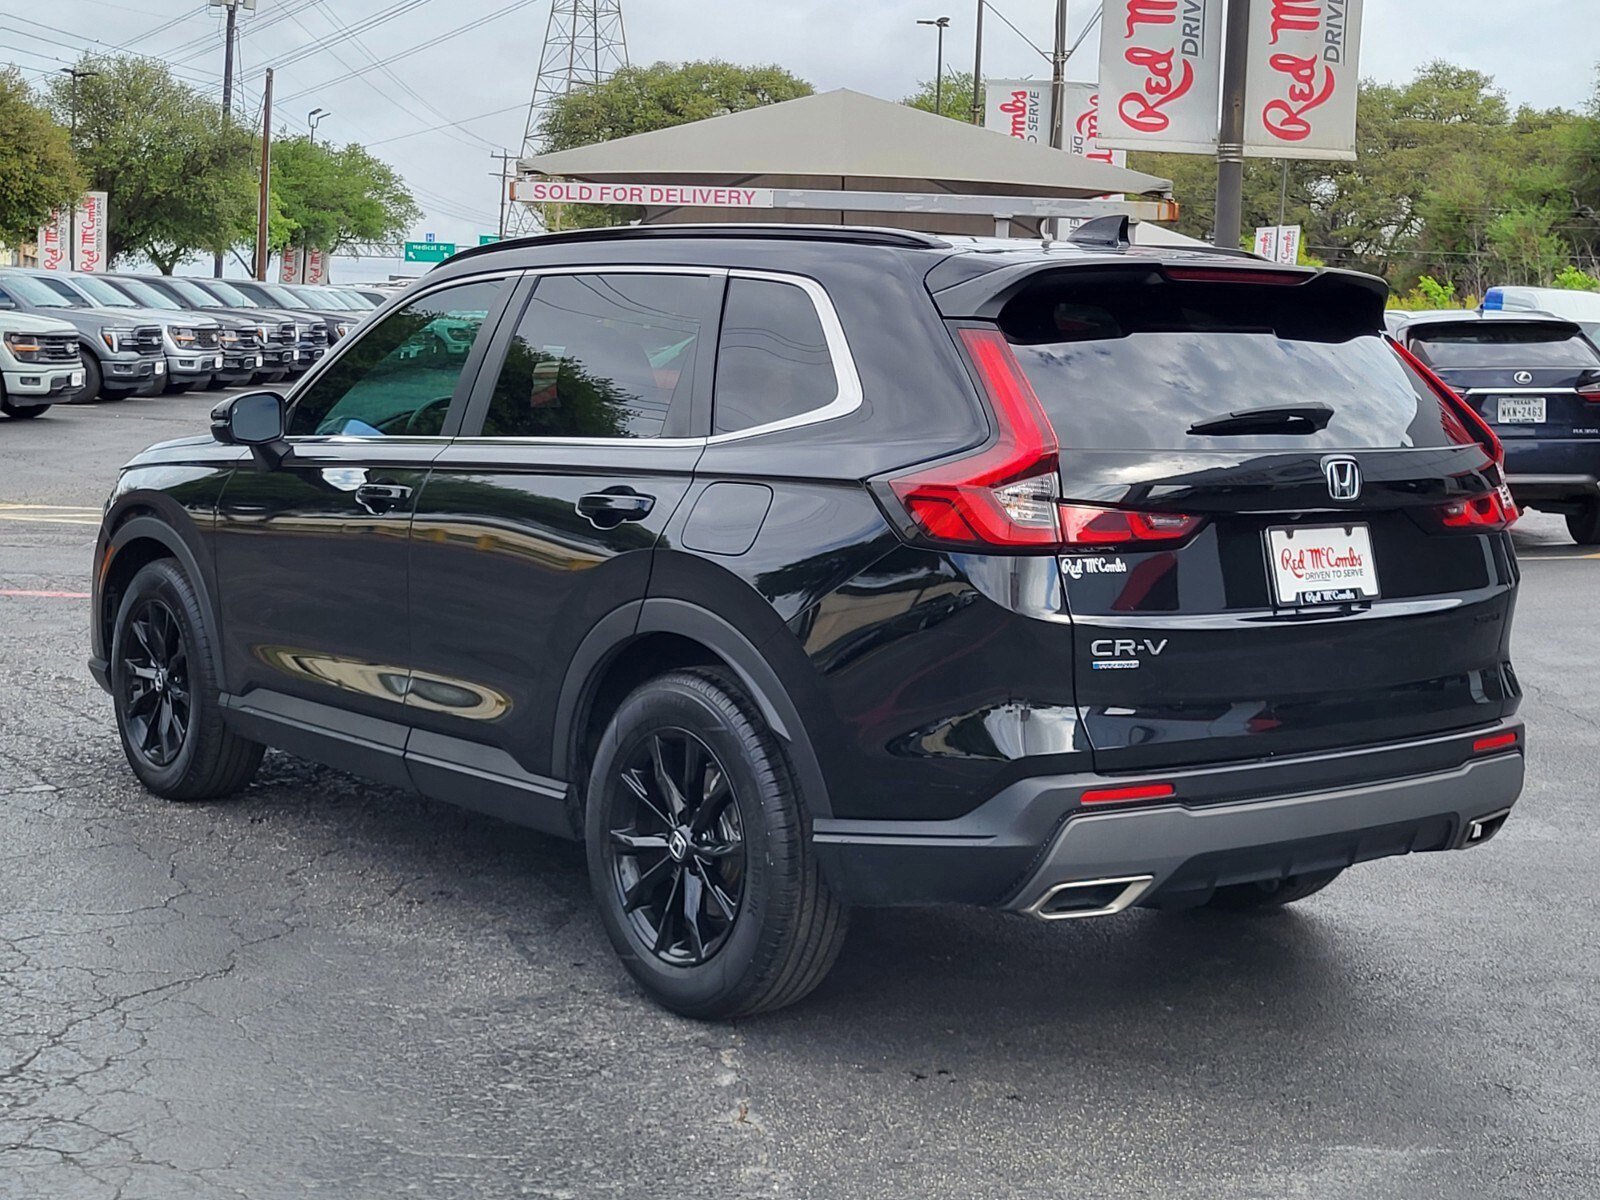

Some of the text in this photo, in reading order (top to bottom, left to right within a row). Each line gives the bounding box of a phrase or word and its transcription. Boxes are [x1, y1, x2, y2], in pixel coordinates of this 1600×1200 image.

[1118, 47, 1194, 133] Red
[1262, 53, 1336, 141] Red
[1028, 90, 1040, 132] SERVE
[533, 184, 757, 205] SOLD FOR DELIVERY
[43, 247, 64, 270] Red
[80, 249, 100, 272] Red
[1061, 557, 1127, 580] Red McCombs
[1281, 546, 1363, 579] Red McCombs
[1305, 568, 1364, 580] DRIVEN TO SERVE
[1304, 589, 1356, 603] Red McCombs
[1091, 638, 1168, 657] CR-V
